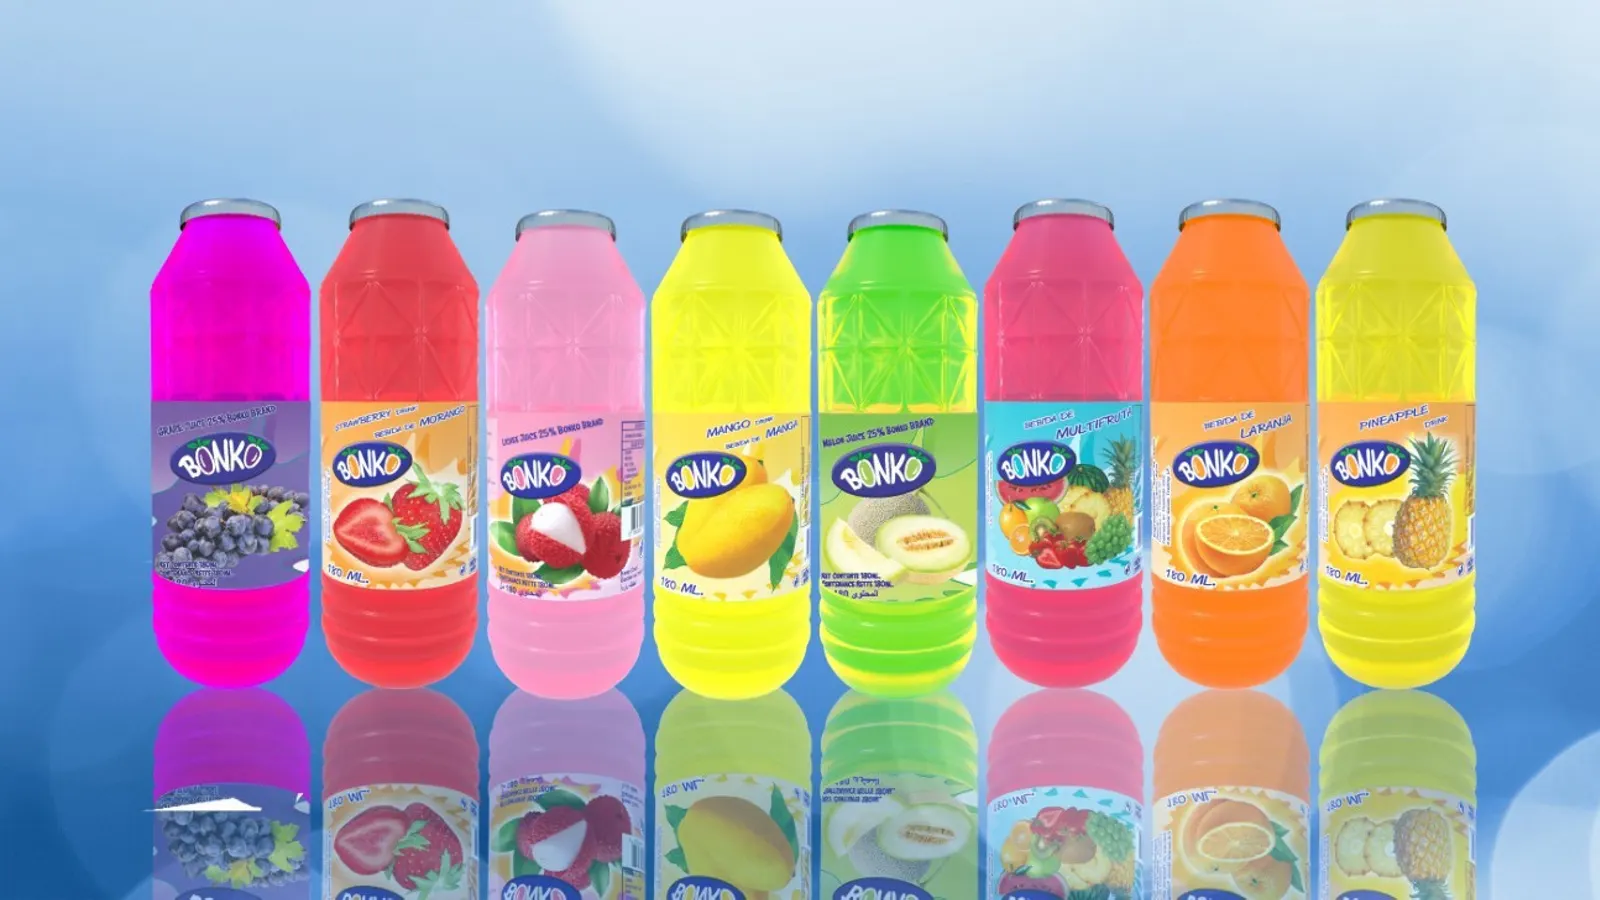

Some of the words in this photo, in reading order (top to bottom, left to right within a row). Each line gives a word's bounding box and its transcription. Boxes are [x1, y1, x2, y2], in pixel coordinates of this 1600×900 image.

[335, 410, 392, 432] STRAWBERRY
[419, 405, 466, 427] MORANGO
[706, 418, 751, 438] MANGO
[765, 419, 799, 439] MANGA
[866, 426, 886, 439] 25%
[909, 416, 935, 430] BRAND
[1240, 414, 1293, 439] LARANJA
[1359, 404, 1429, 431] PINEAPPLE
[1424, 415, 1449, 429] DRINK
[178, 438, 263, 478] BONKO
[337, 448, 402, 481] BONKO
[840, 451, 923, 491] BONKO
[1001, 448, 1067, 481] BONKO
[1177, 448, 1250, 482] BONKO
[1335, 448, 1401, 481] BONKO
[502, 459, 567, 492] BONKO
[670, 459, 737, 492] BONKO
